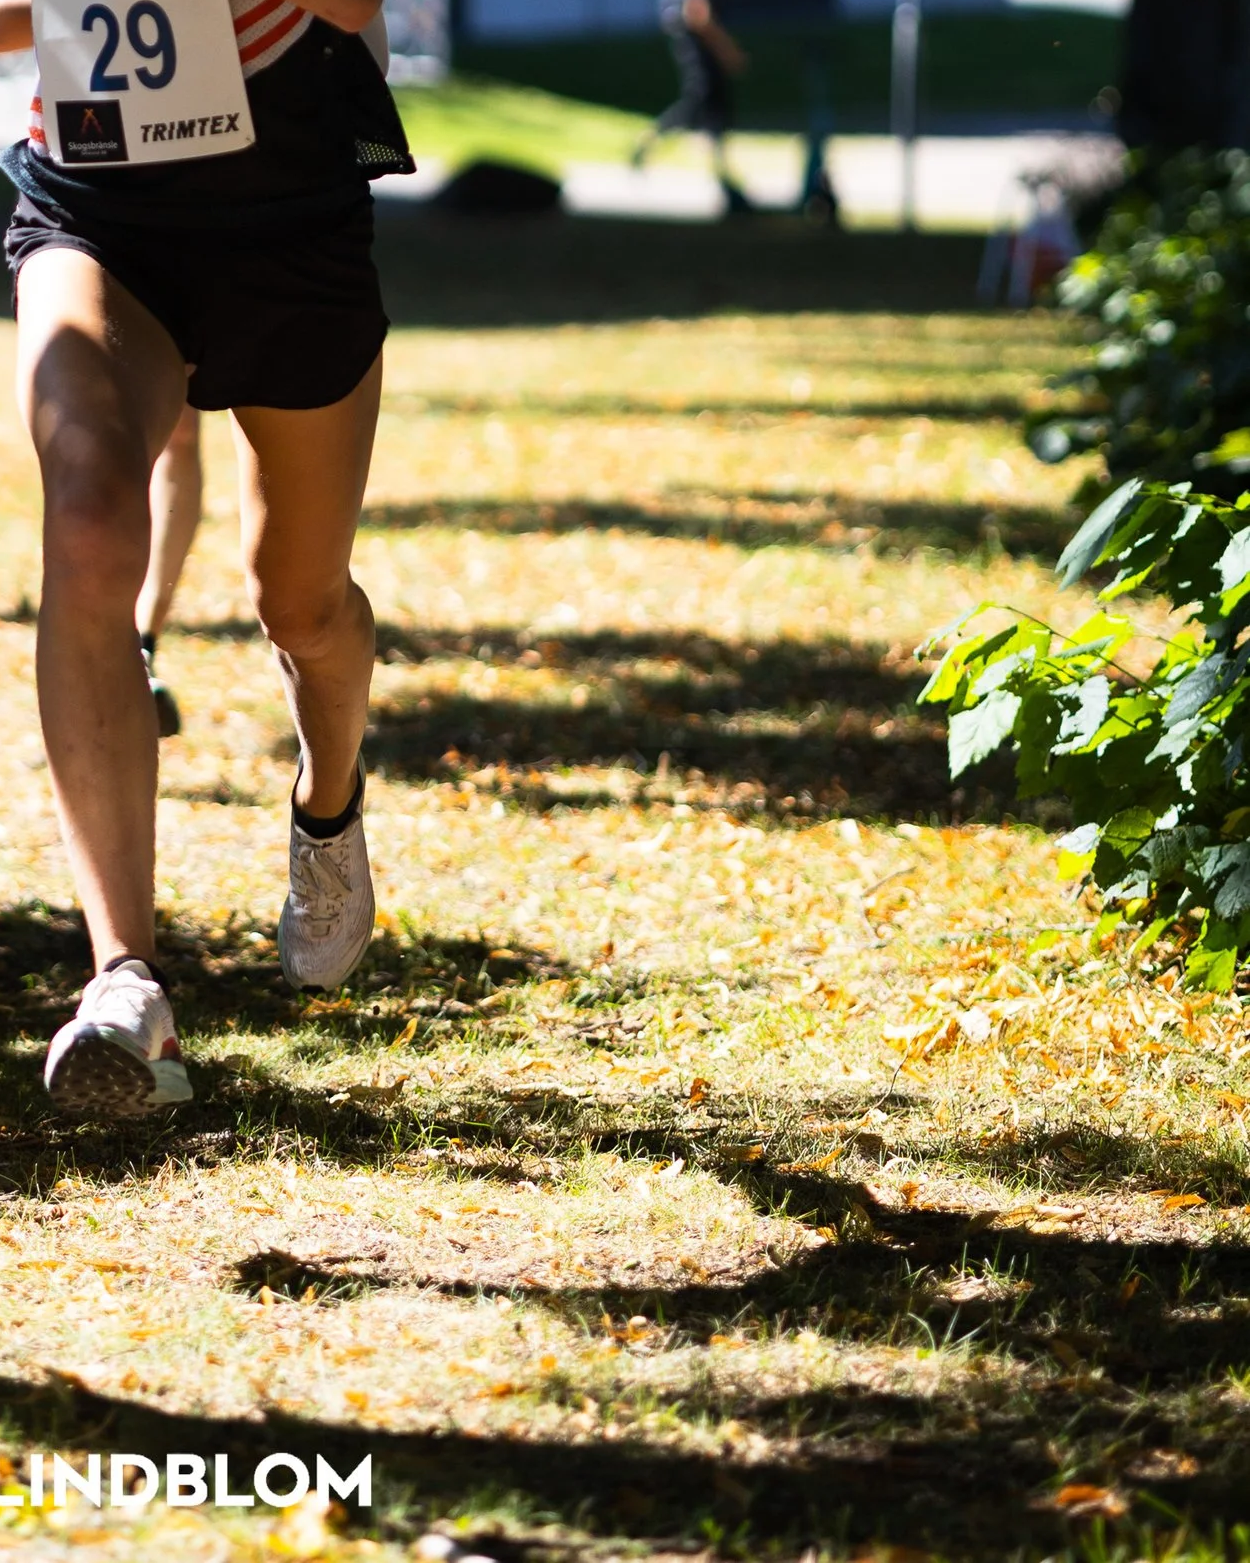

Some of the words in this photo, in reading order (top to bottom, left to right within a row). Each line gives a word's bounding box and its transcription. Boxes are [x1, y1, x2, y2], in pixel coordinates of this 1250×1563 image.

[81, 0, 177, 93] 29
[140, 112, 240, 143] TRIMTEX
[67, 140, 119, 151] Skogsbränsle
